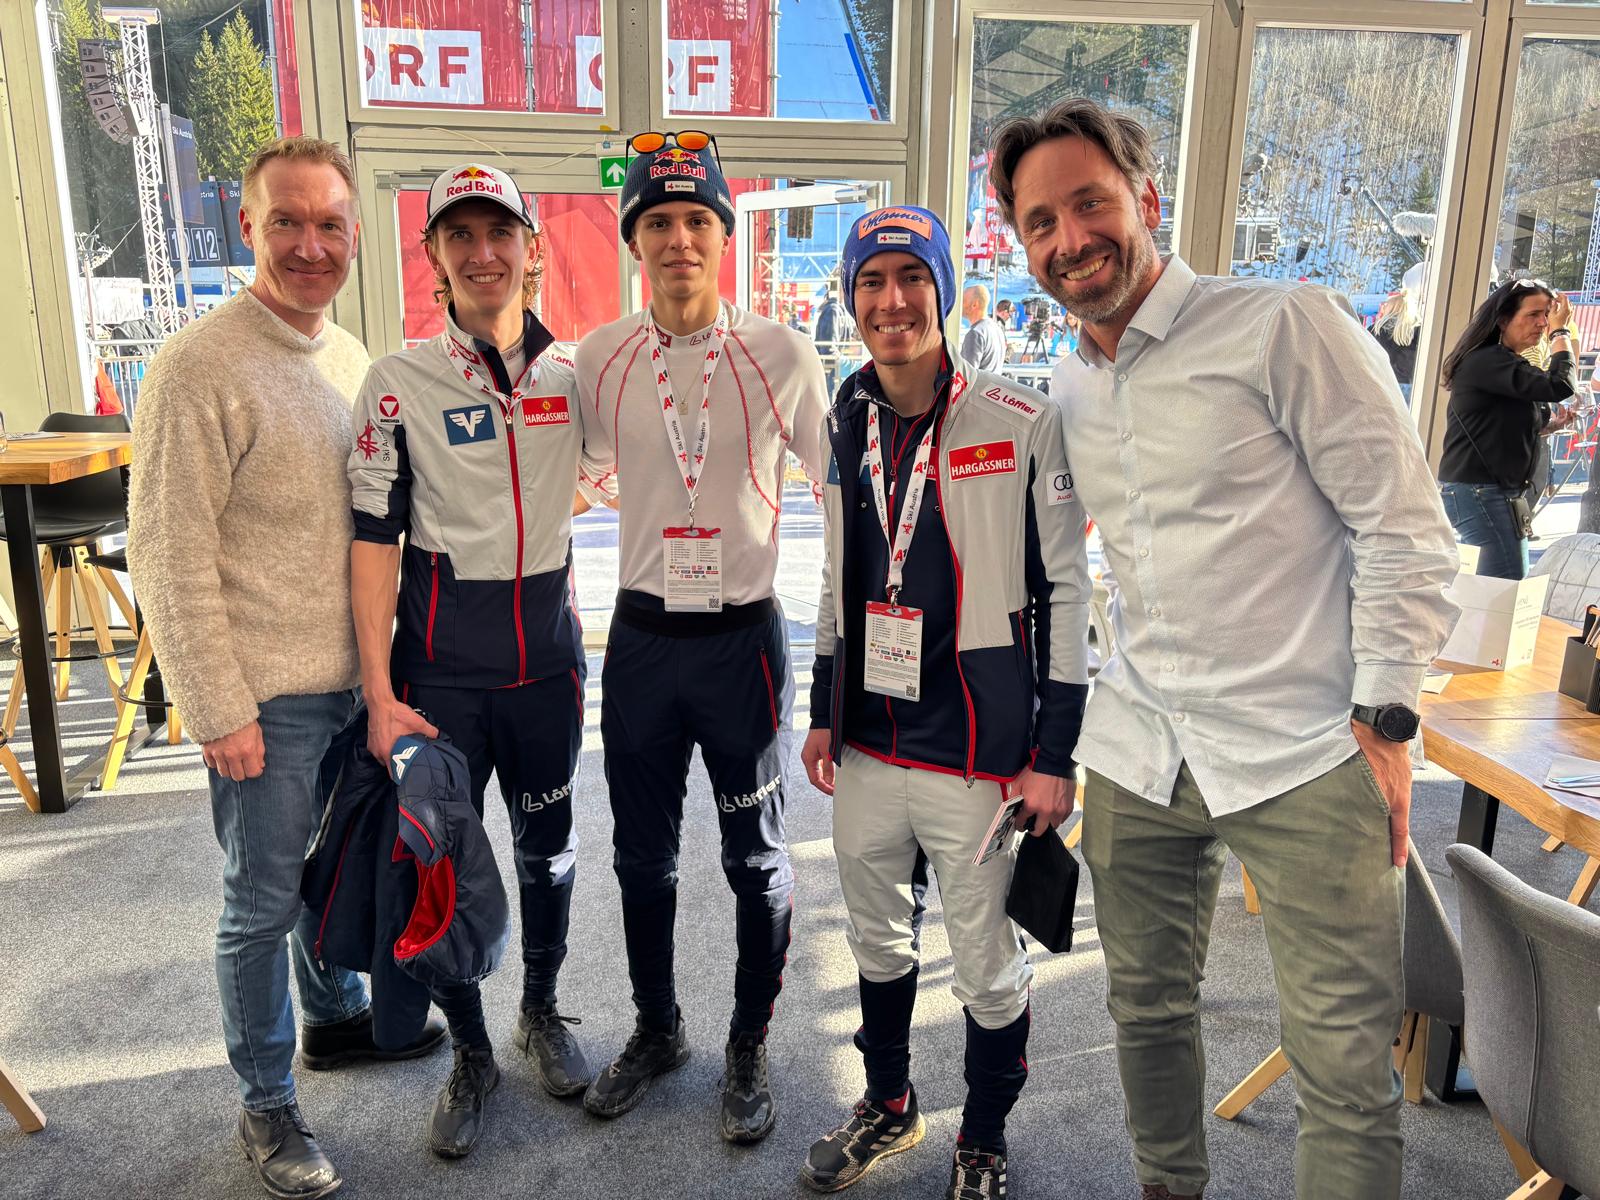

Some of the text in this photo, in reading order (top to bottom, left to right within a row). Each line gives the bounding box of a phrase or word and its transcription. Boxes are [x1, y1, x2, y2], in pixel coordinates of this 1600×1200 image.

[363, 43, 470, 88] RF
[650, 163, 707, 181] Red Bull
[447, 181, 503, 198] Red Bull
[863, 211, 928, 232] Manner
[195, 230, 217, 259] 12
[706, 350, 720, 361] A1
[657, 369, 668, 385] A1
[664, 394, 674, 410] A1
[1002, 395, 1037, 415] Löffler
[524, 411, 569, 424] HARGASSNER
[869, 411, 877, 426] A1
[869, 436, 879, 452] A1
[383, 449, 391, 462] Ski
[871, 461, 882, 477] A1
[913, 460, 928, 474] A1
[951, 458, 1015, 477] HARGASSNER
[909, 488, 919, 512] Austria
[1056, 493, 1073, 501] Audi
[893, 548, 908, 562] A1
[733, 774, 781, 808] Löffler
